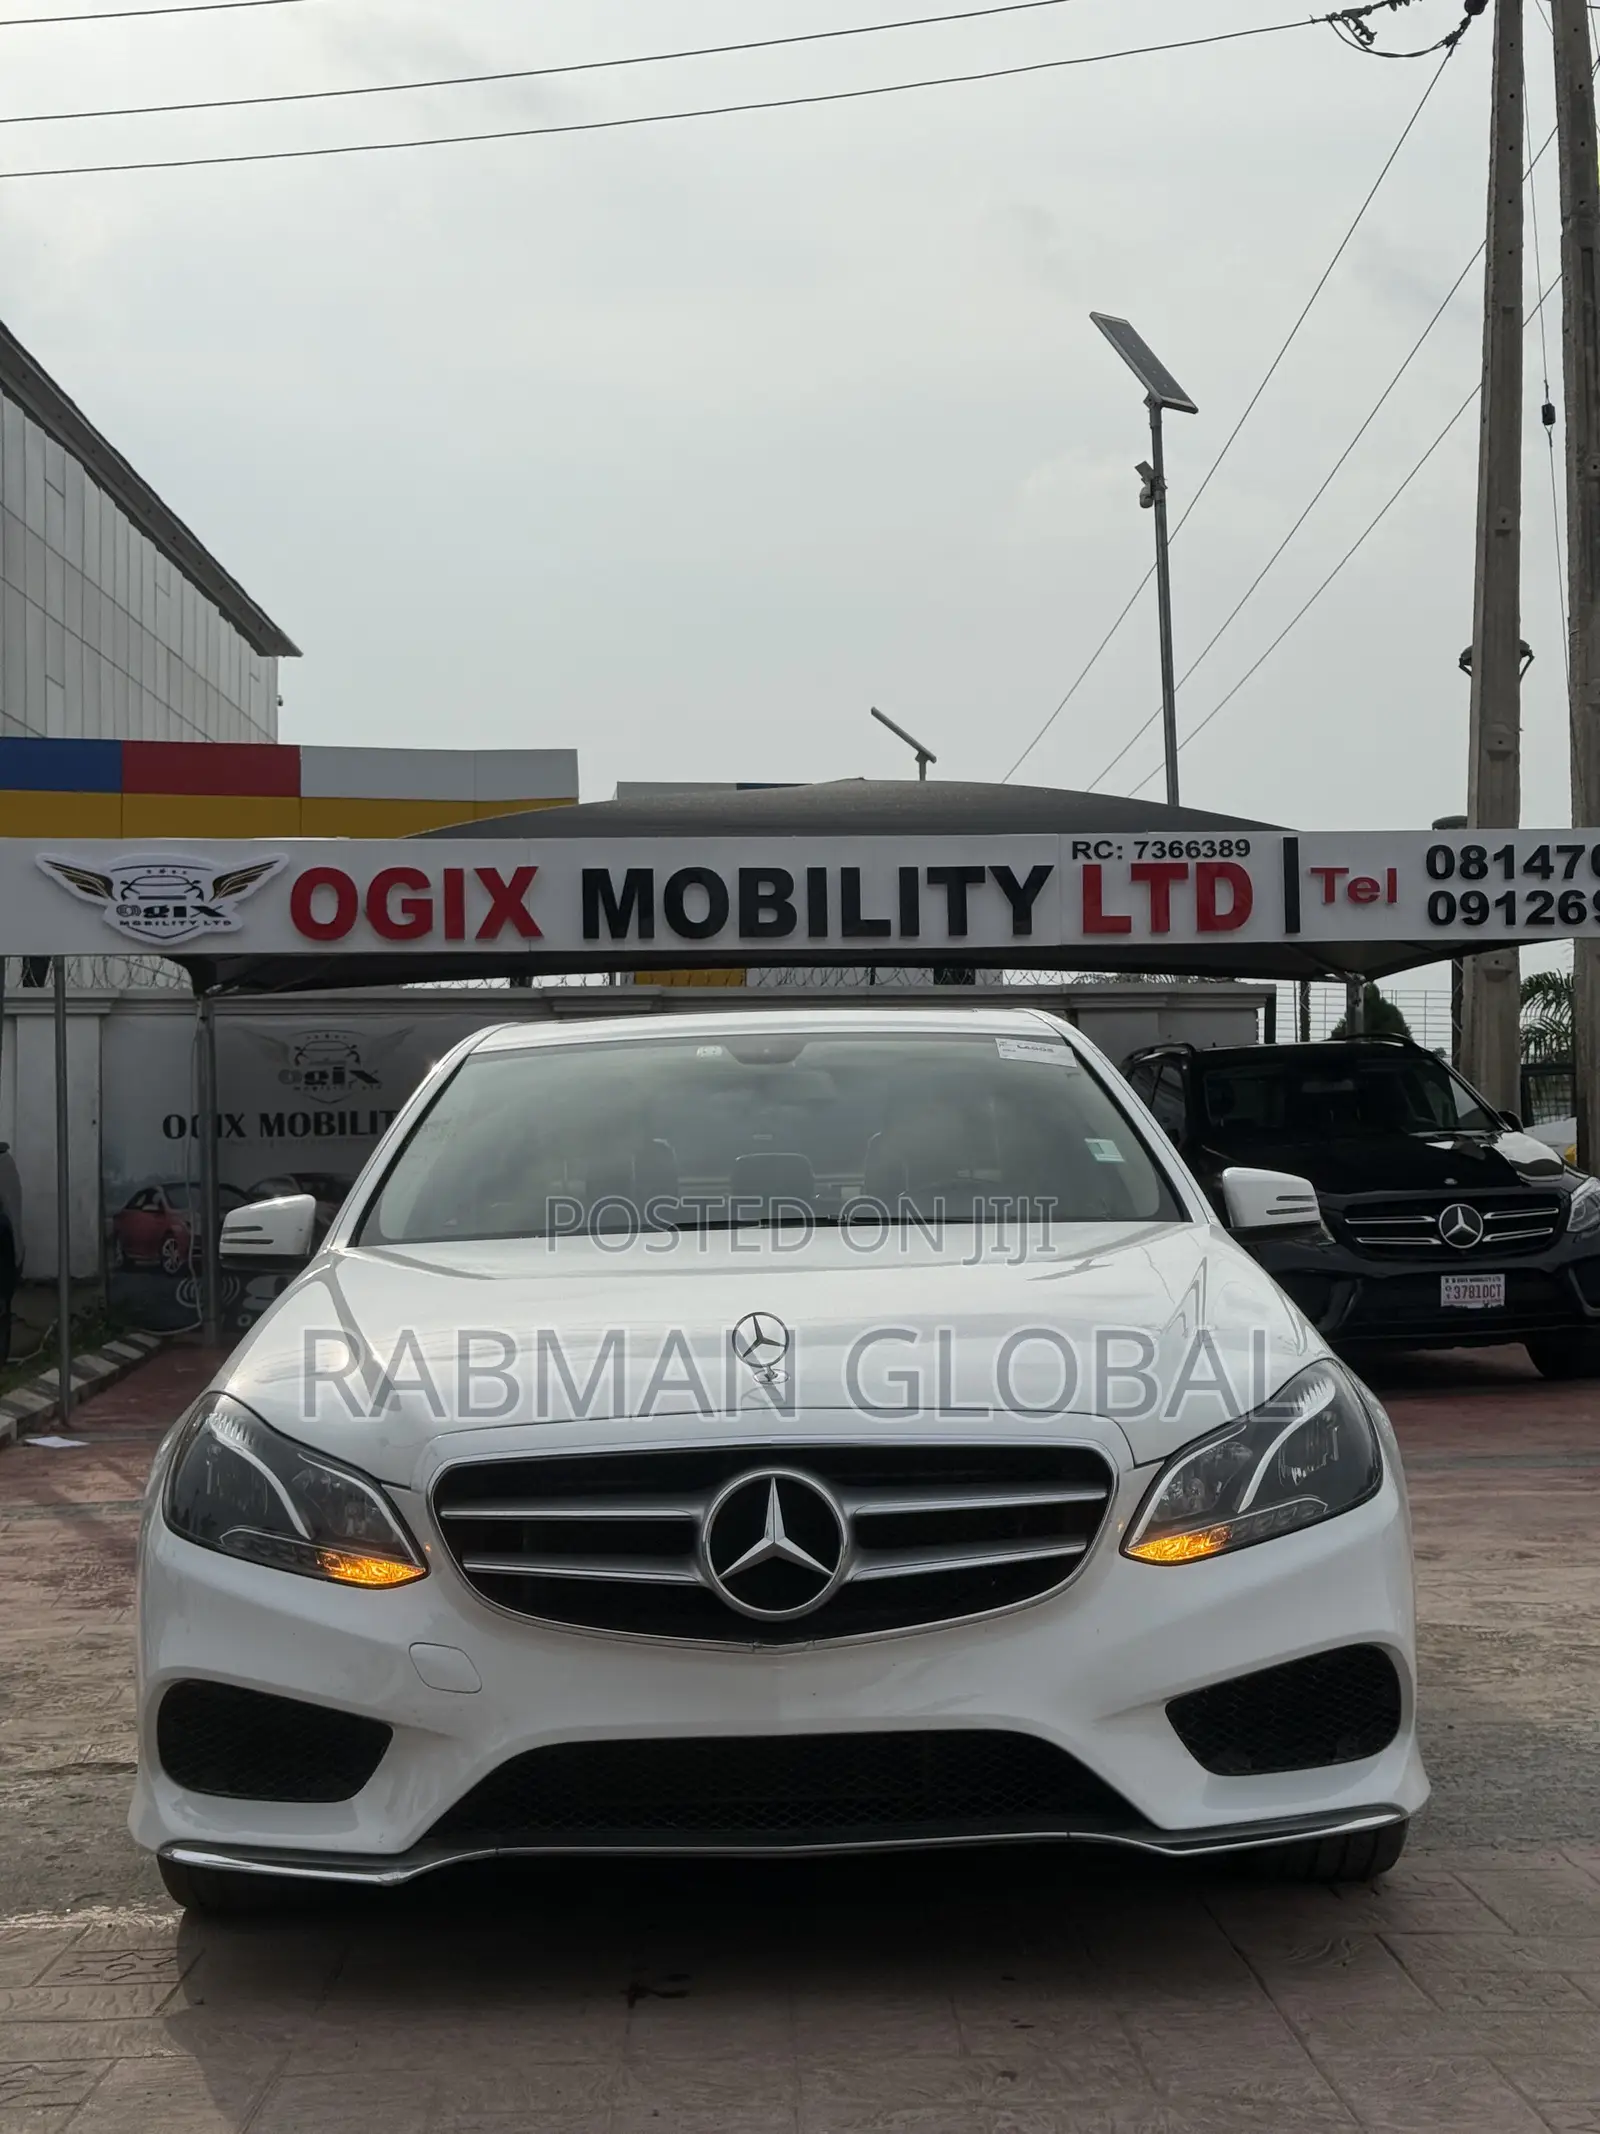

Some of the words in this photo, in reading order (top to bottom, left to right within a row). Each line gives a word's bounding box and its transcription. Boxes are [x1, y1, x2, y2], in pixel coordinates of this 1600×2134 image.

[1072, 840, 1123, 860] RC:
[1134, 839, 1251, 860] 7366389
[290, 866, 545, 941] OGIX
[582, 865, 1055, 939] MOBILITY
[1082, 862, 1254, 934] LTD
[1310, 867, 1397, 904] Tel
[1428, 889, 1600, 926] 09126
